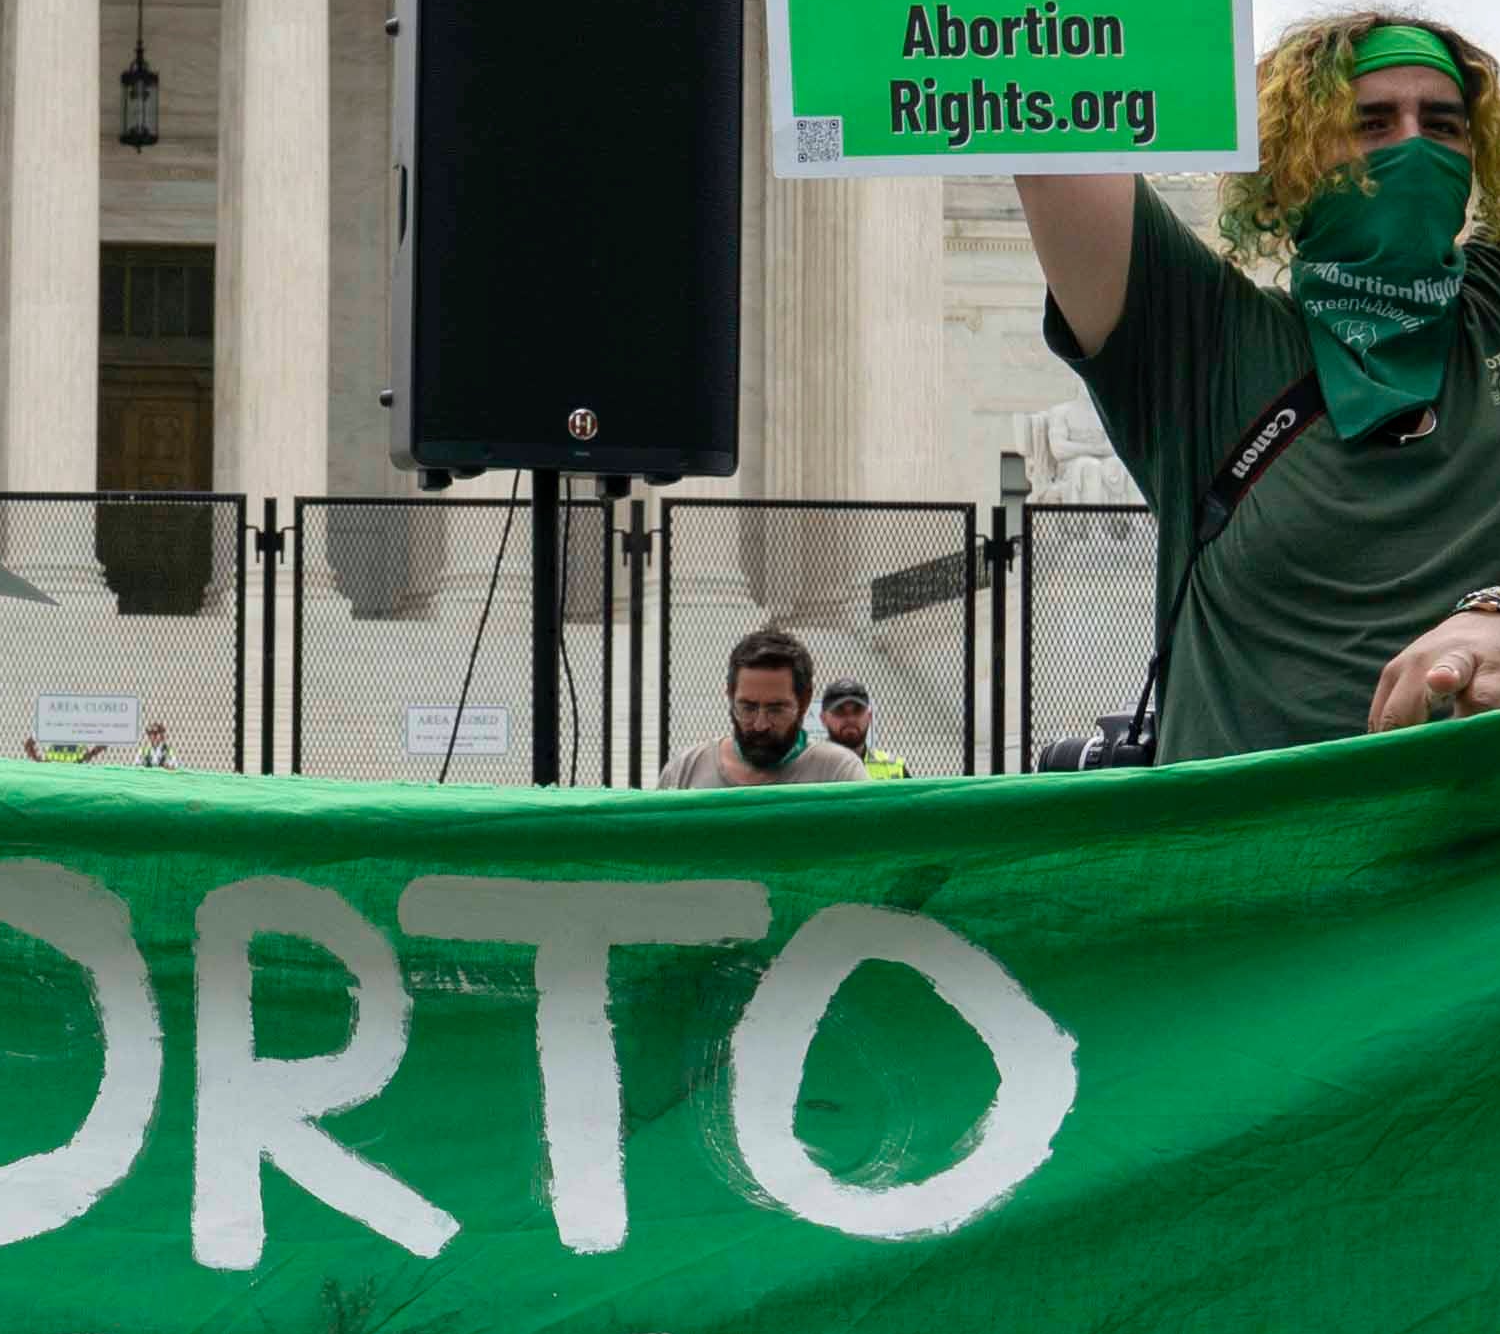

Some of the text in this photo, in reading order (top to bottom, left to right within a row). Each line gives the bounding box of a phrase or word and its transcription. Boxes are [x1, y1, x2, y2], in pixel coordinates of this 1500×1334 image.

[902, 1, 1125, 58] Abortion
[890, 77, 1156, 147] Rights.org
[1231, 408, 1297, 479] Canon
